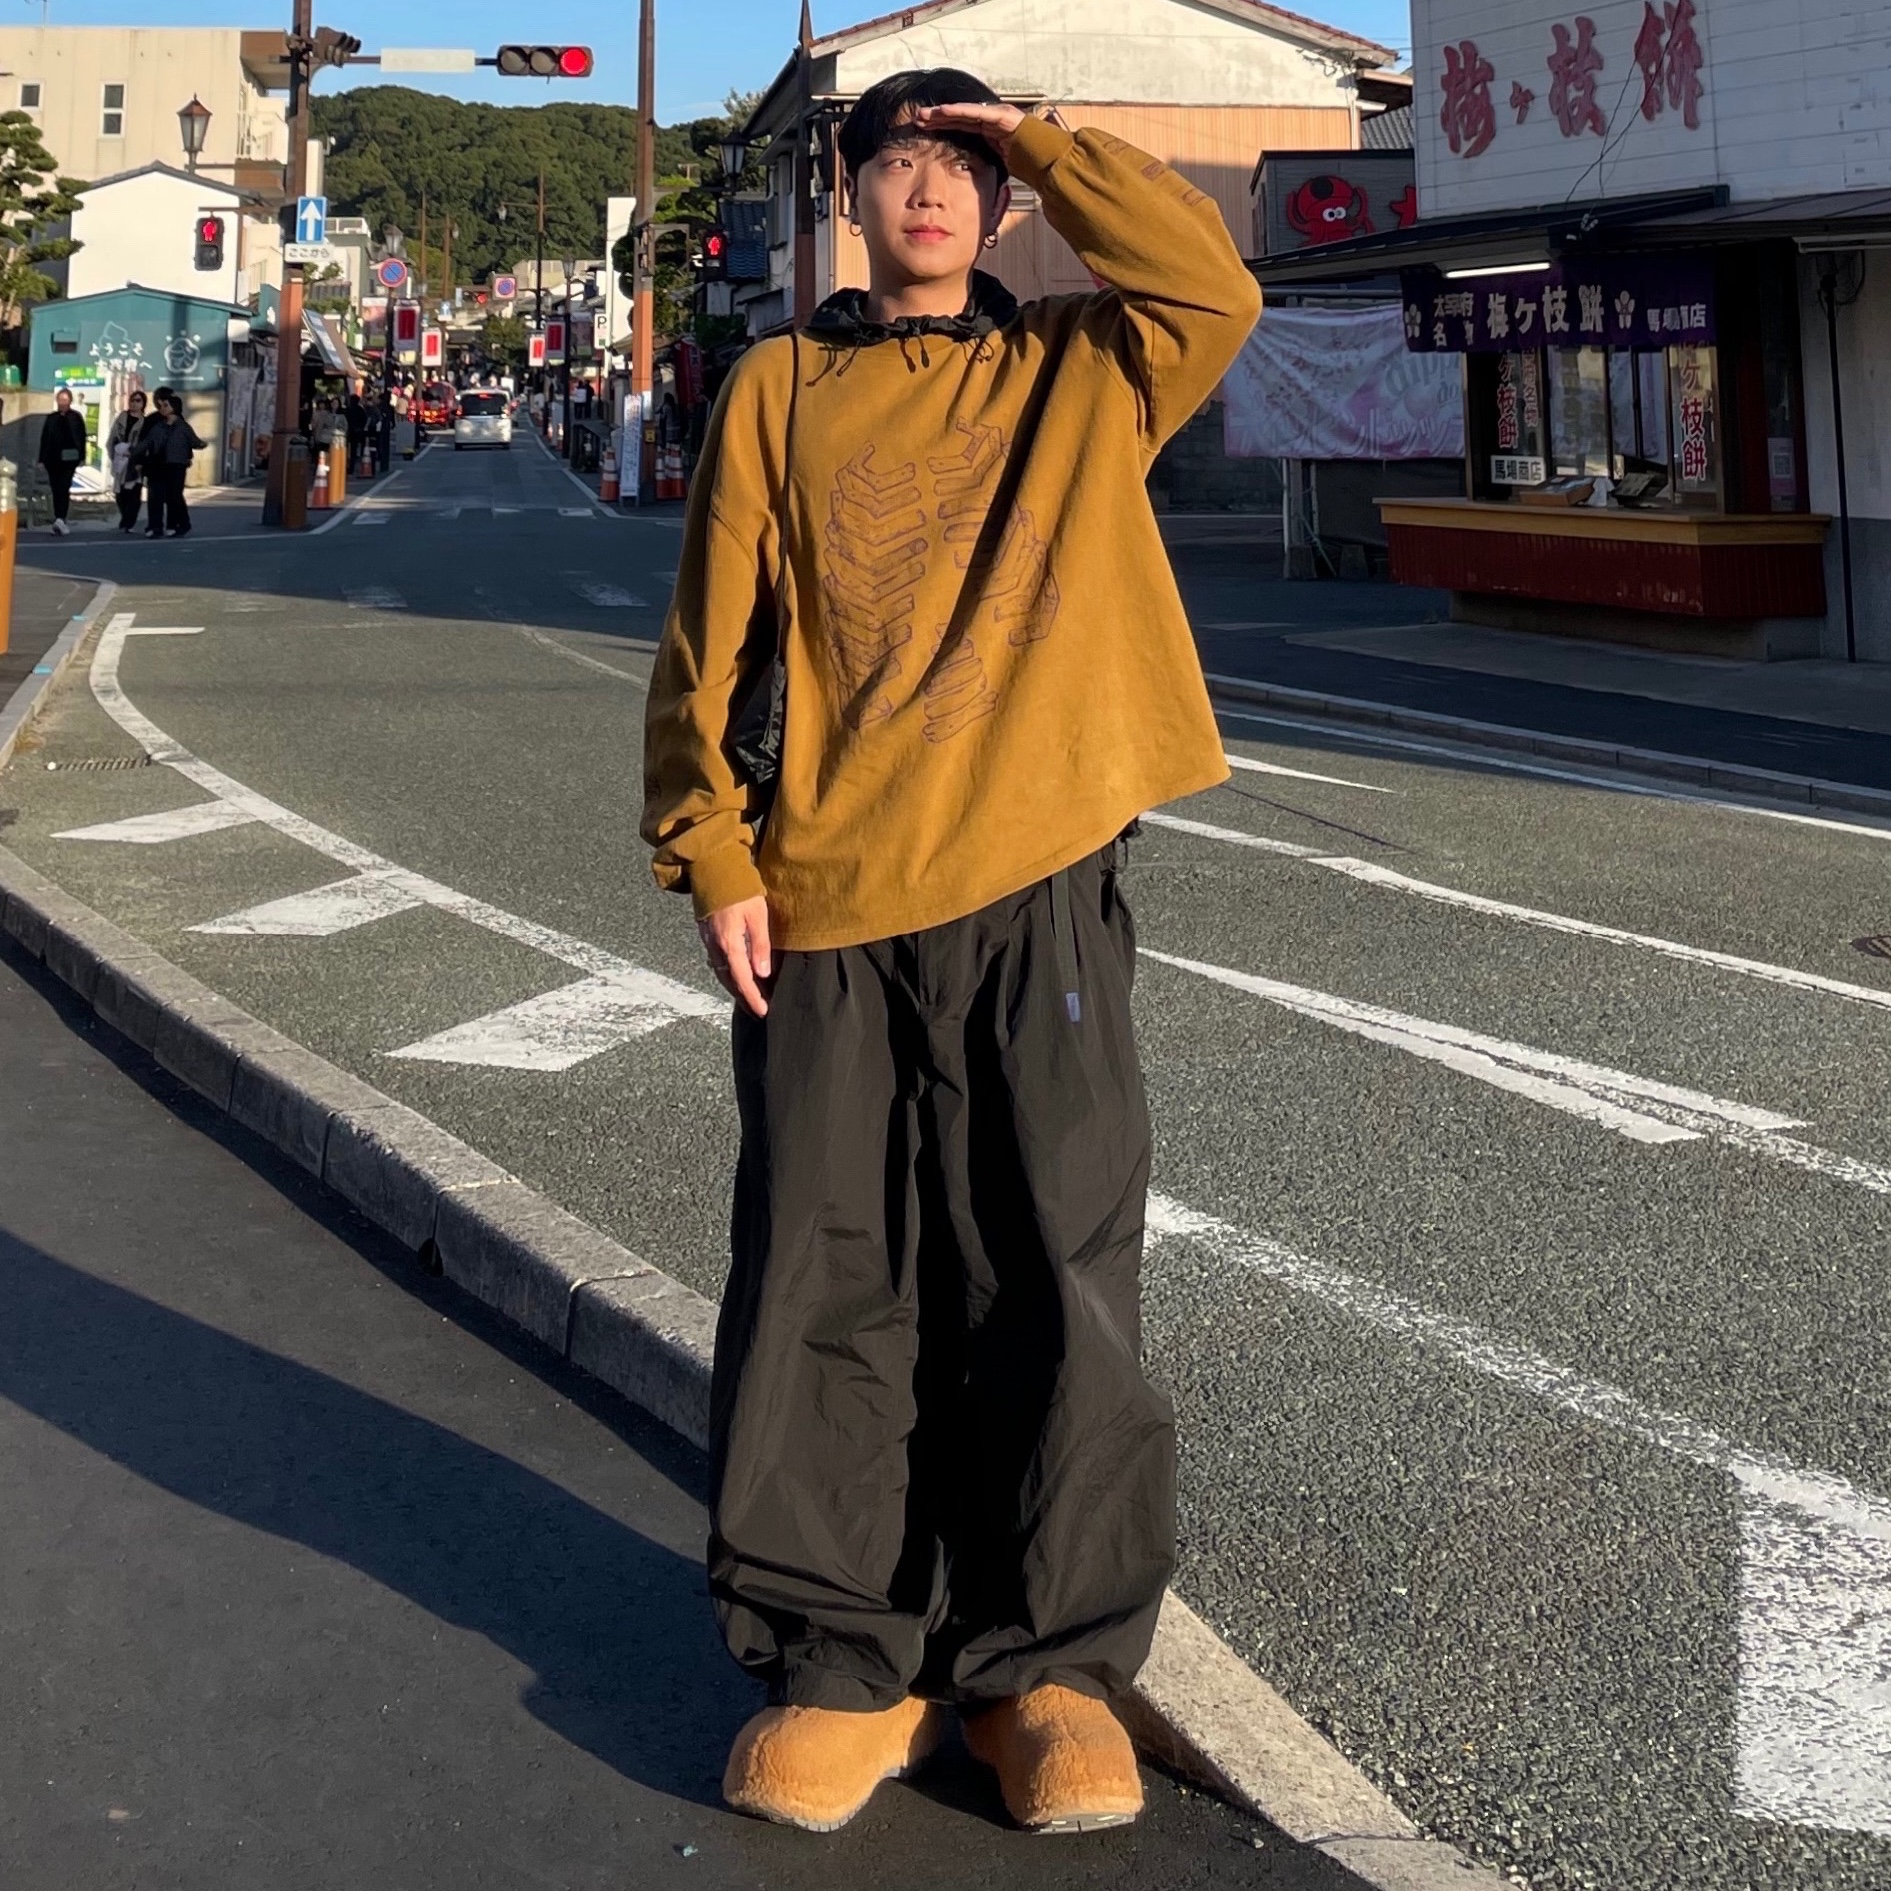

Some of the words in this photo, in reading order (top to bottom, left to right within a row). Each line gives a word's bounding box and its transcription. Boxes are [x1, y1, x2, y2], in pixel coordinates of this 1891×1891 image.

[289, 247, 330, 259] ここから
[1433, 291, 1474, 318] 太宰府
[597, 315, 607, 329] P
[89, 341, 144, 356] ようこそ
[1680, 345, 1708, 481] ケ枝餅
[1494, 459, 1542, 482] 馬場商店
